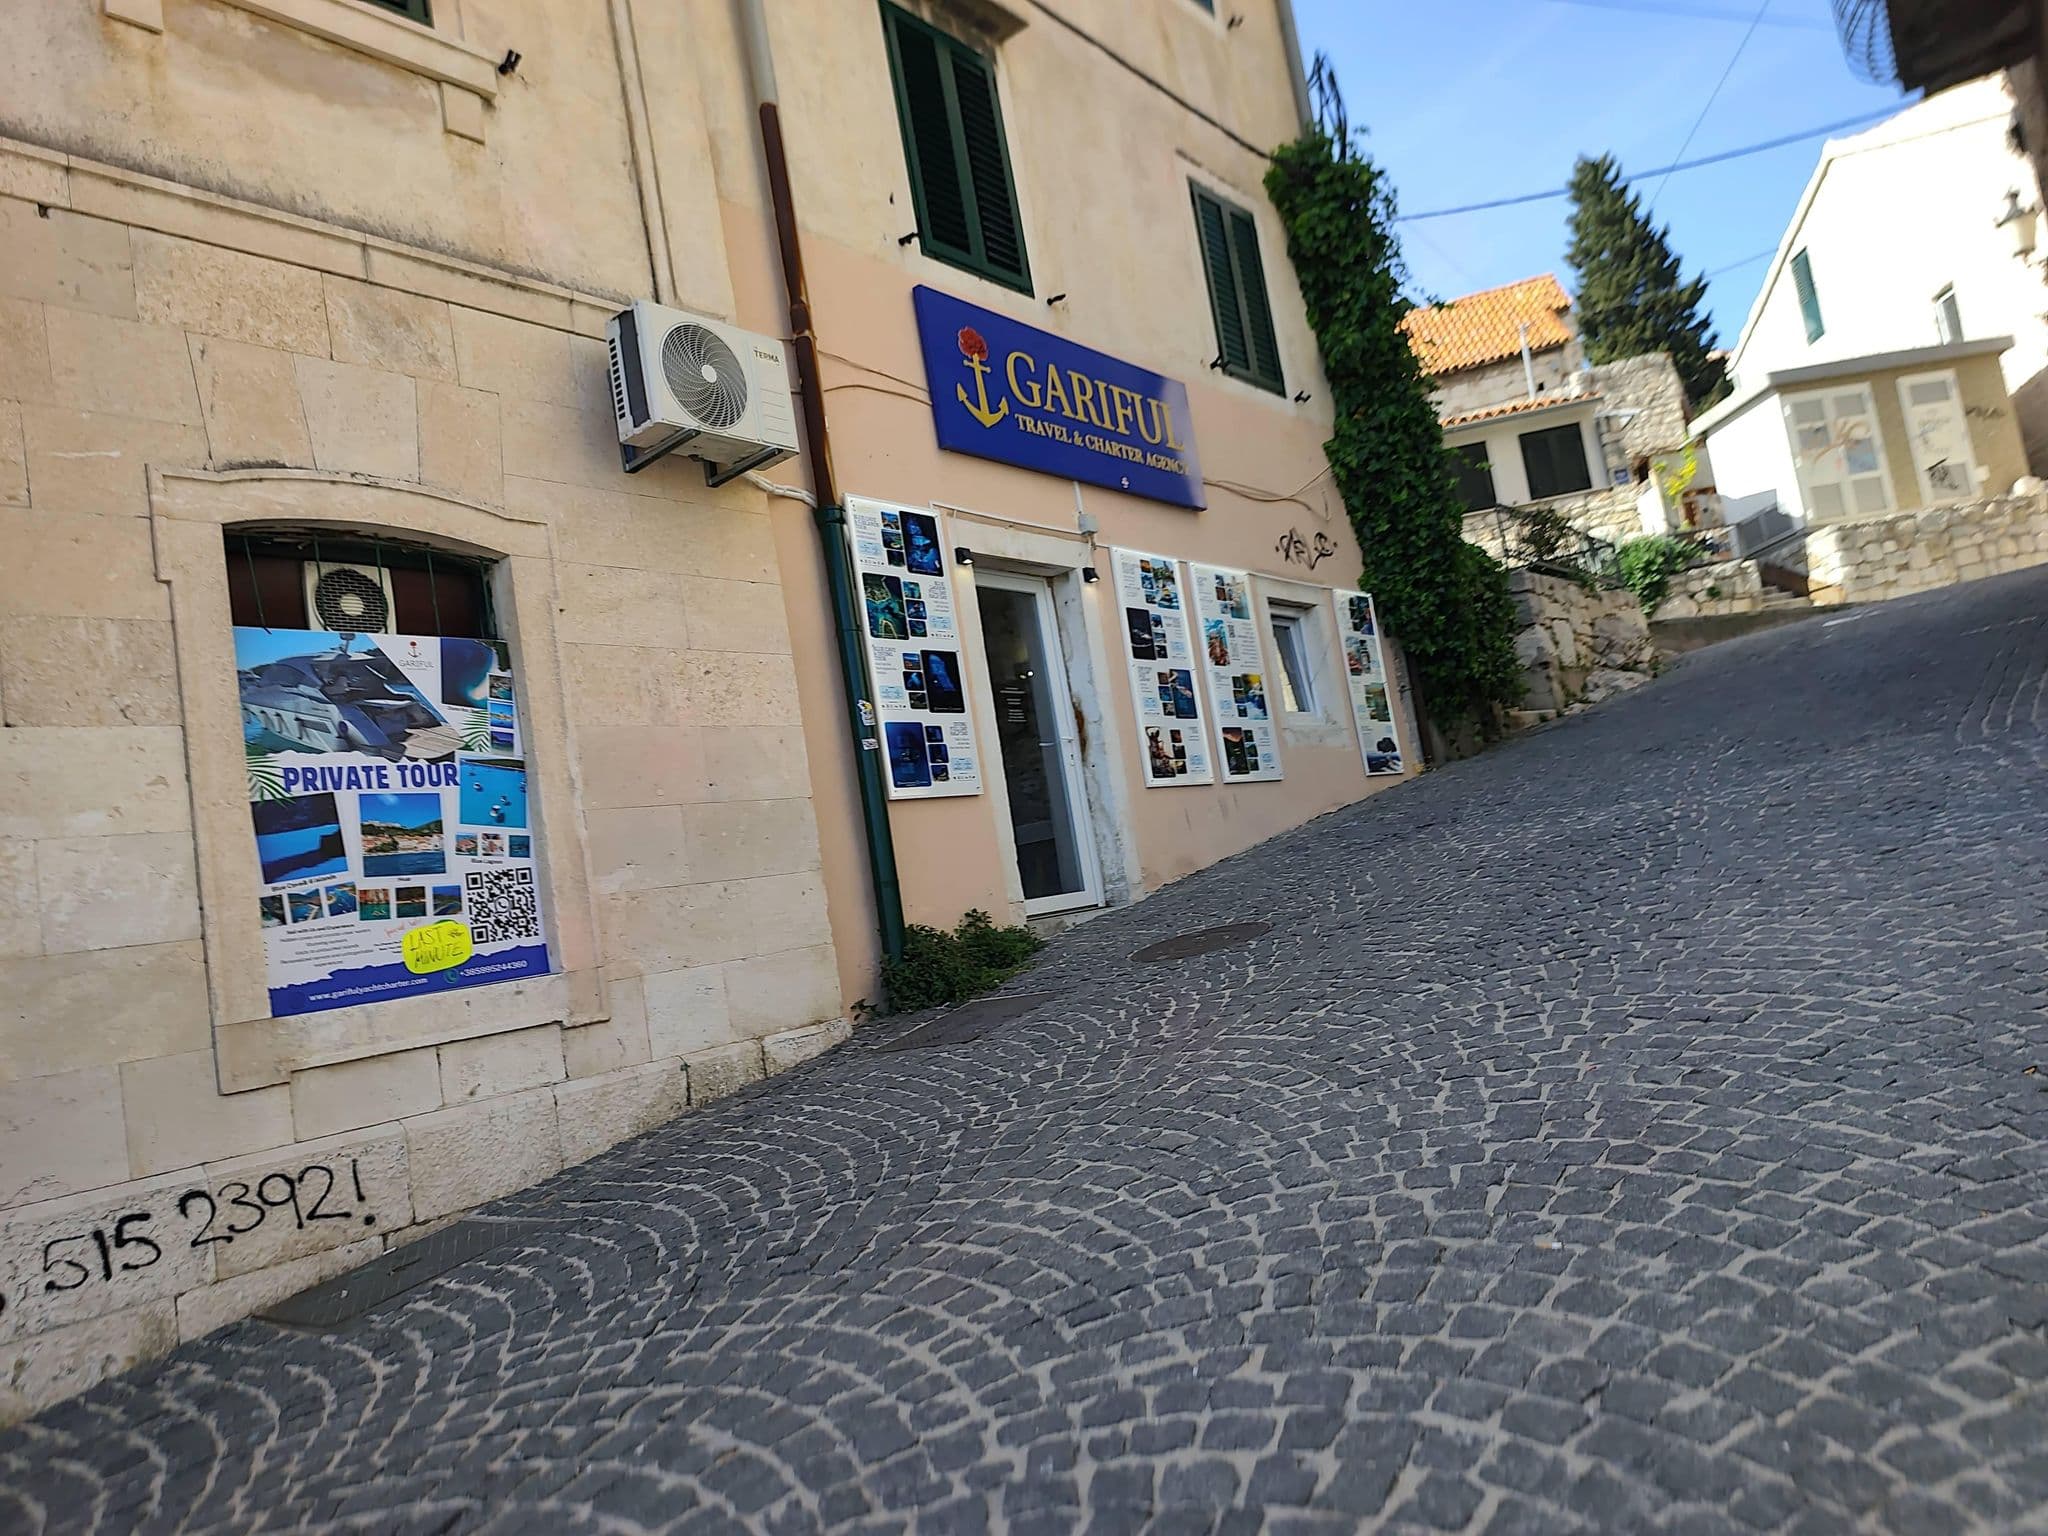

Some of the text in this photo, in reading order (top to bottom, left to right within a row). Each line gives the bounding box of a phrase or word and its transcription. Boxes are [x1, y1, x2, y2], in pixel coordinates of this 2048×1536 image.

[753, 349, 780, 363] TERMA
[1006, 351, 1185, 450] GARIFUL
[1014, 413, 1072, 444] TRAVEL
[1073, 430, 1085, 447] &
[1085, 434, 1144, 464] CHARTER
[283, 763, 461, 793] PRIVATE TOUR
[409, 926, 443, 951] LAST
[415, 943, 464, 968] MINUTE
[43, 1159, 377, 1292] 515 2392!
